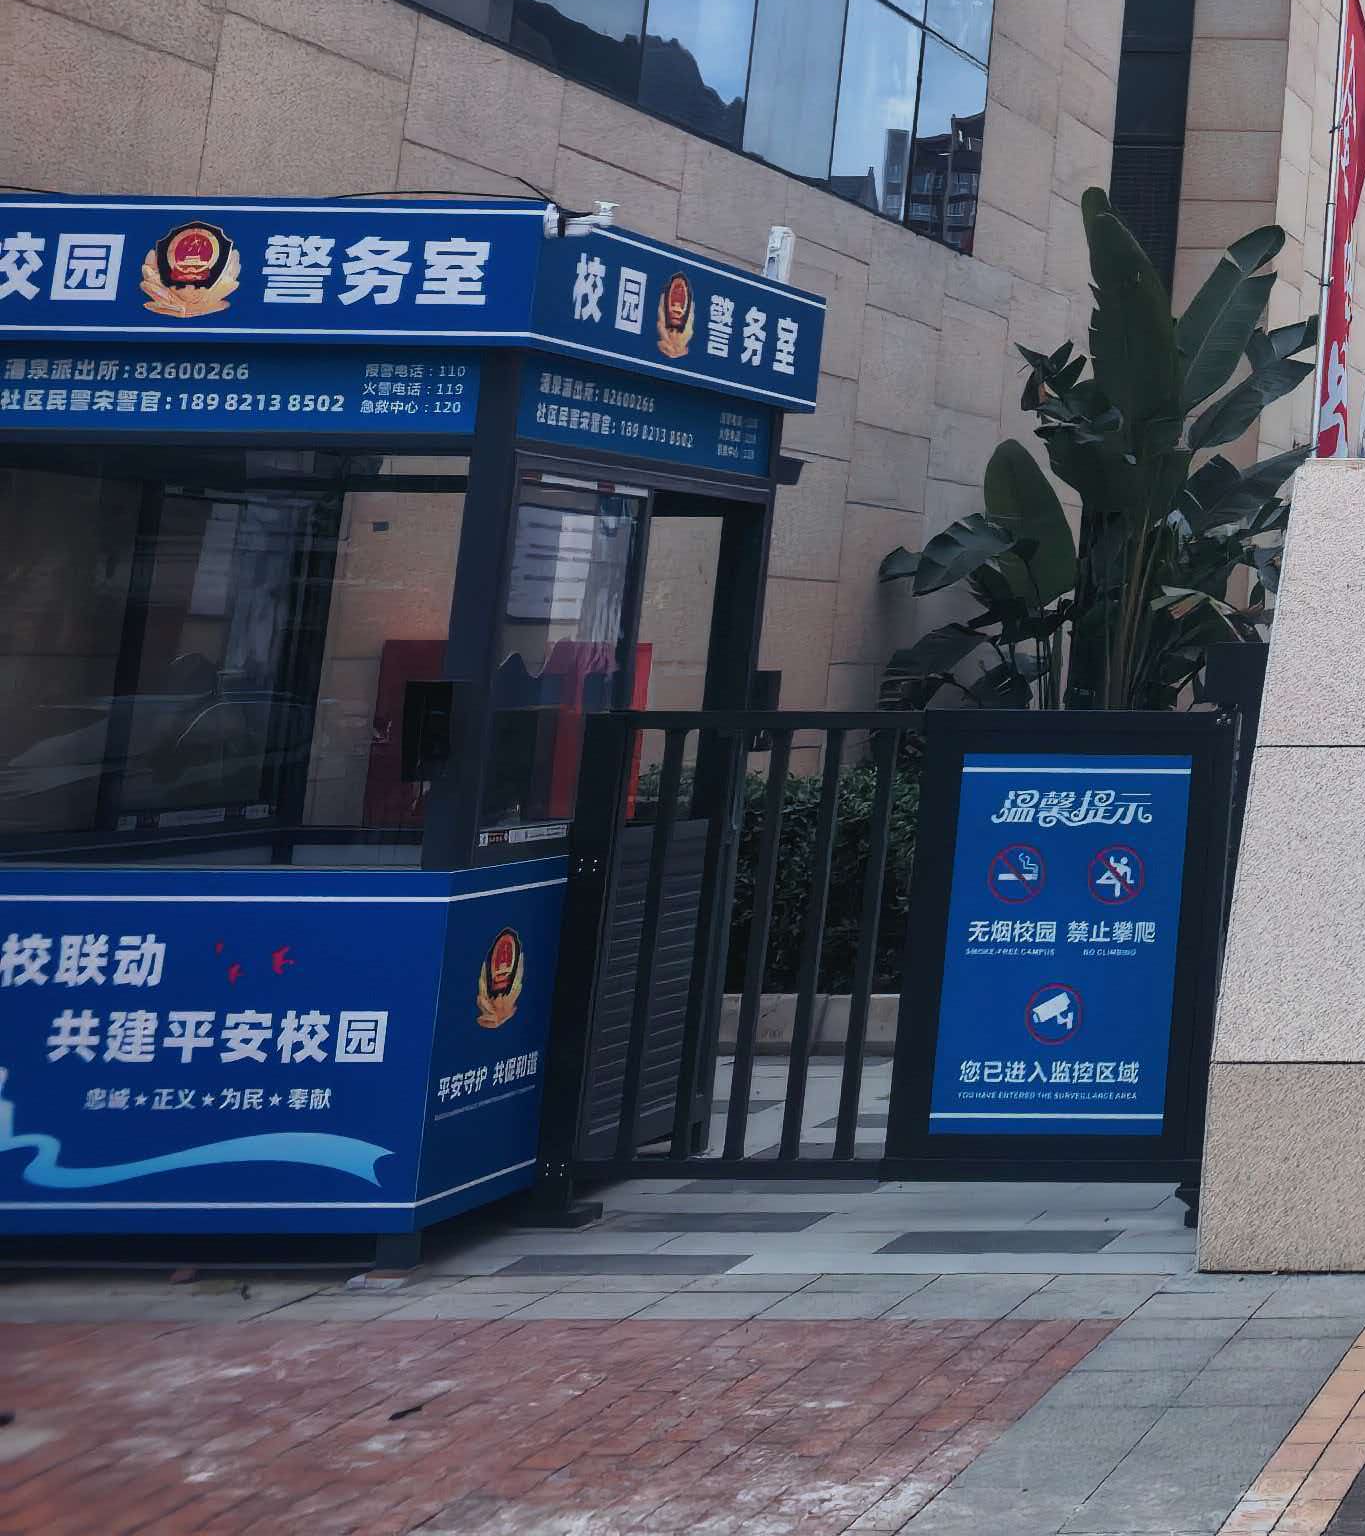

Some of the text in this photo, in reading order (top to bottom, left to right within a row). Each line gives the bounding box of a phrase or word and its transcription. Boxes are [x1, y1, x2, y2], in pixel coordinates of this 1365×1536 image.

[262, 234, 490, 306] 警务室
[573, 253, 798, 375] 校园 警务室
[991, 790, 1153, 827] 温馨提示
[968, 920, 1156, 943] 无烟校园 禁止攀爬
[0, 933, 167, 987] 校联动
[47, 1009, 389, 1064] 共建平安校园
[959, 1060, 1140, 1084] 您已进入监控区域
